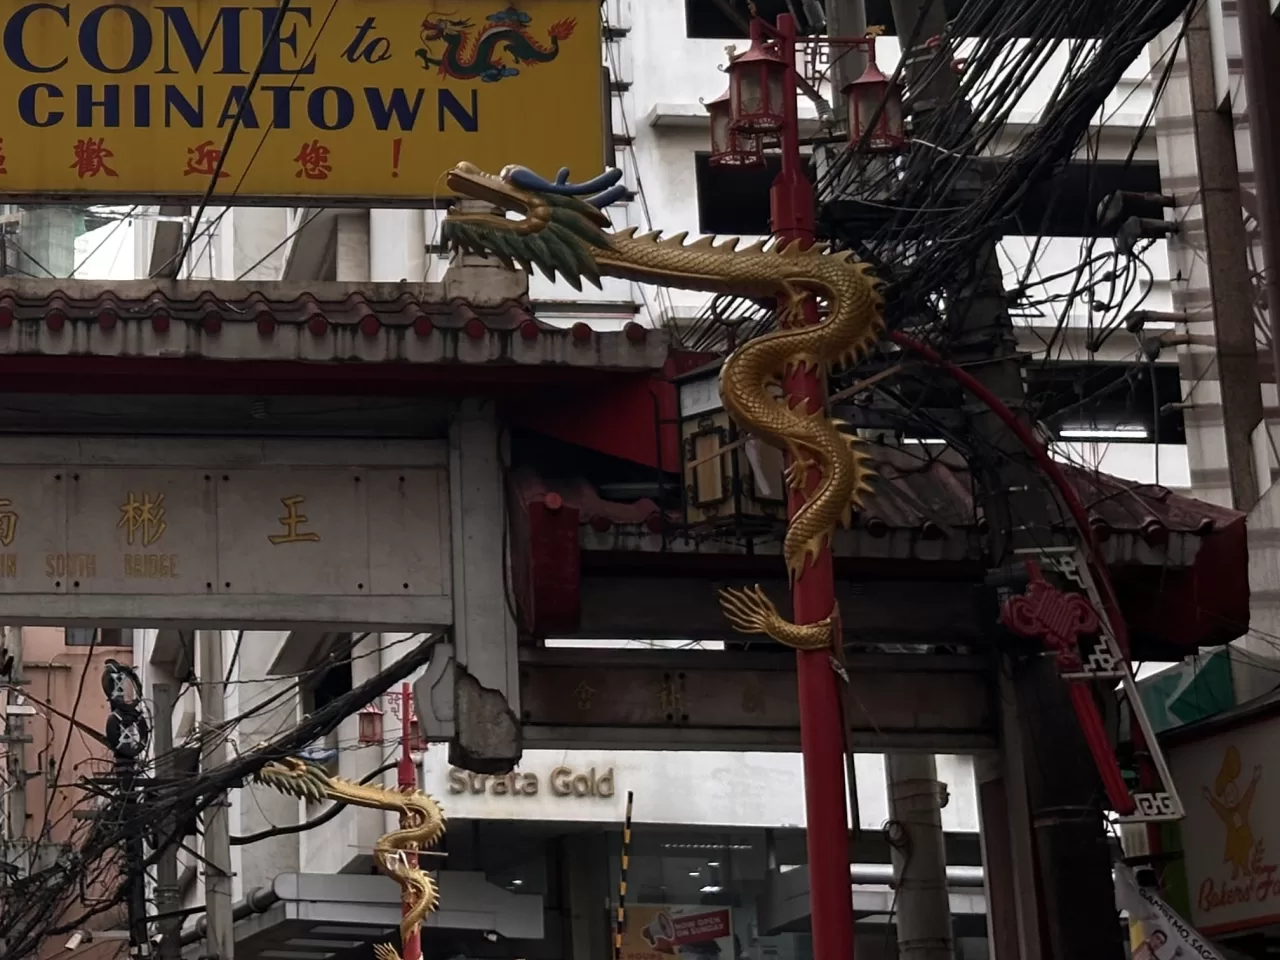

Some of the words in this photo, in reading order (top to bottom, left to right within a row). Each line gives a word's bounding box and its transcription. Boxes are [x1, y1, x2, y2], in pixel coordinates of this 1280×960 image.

[340, 16, 392, 64] to
[18, 83, 479, 132] CHINATOWN
[45, 553, 97, 579] SOUTH
[124, 553, 180, 579] BRIDGE
[448, 766, 539, 796] Strata
[550, 765, 615, 798] Gold
[697, 917, 721, 926] OPEN
